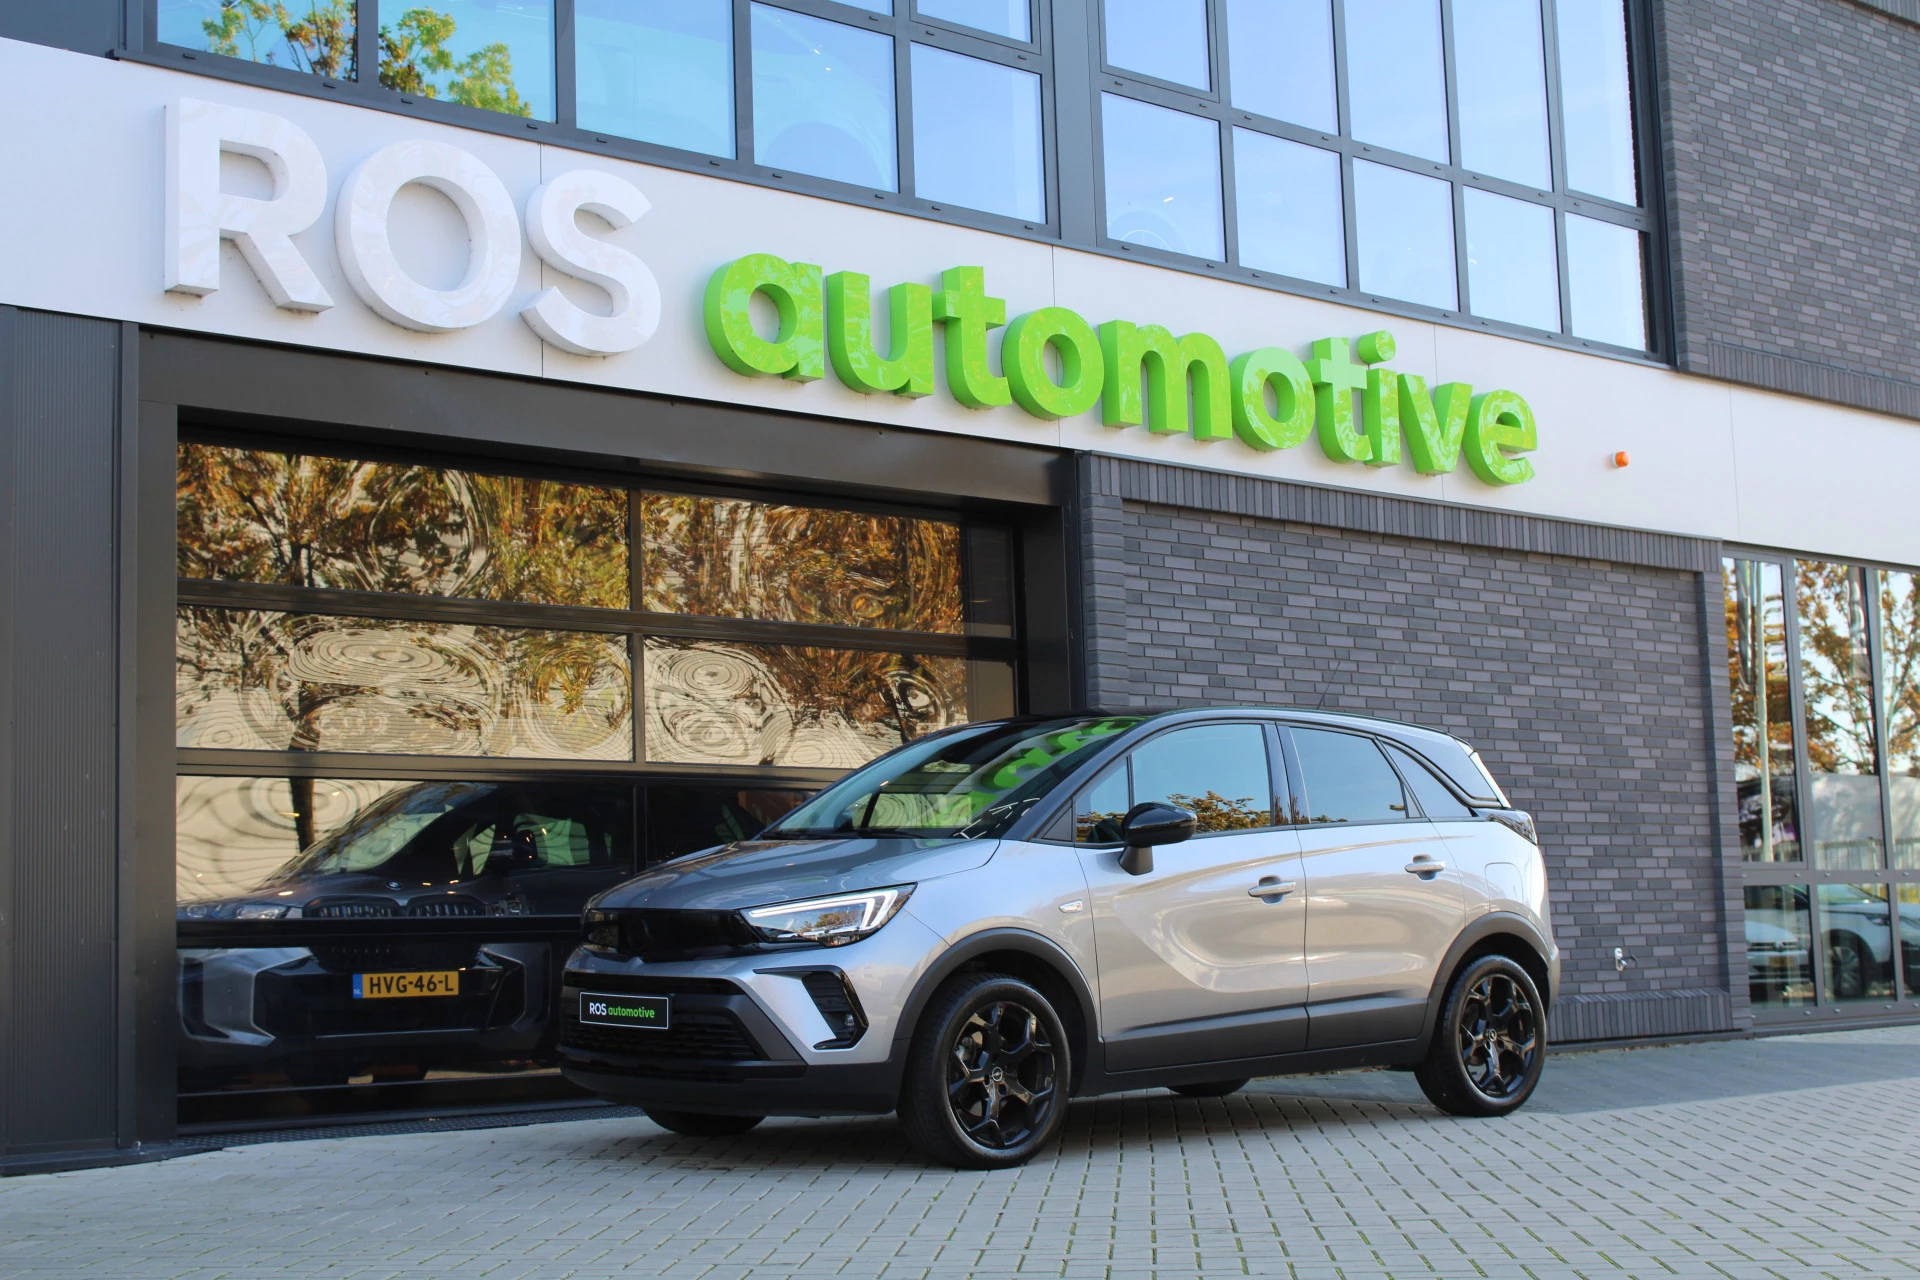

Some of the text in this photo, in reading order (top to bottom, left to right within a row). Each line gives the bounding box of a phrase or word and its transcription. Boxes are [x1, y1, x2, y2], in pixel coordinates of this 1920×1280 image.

[163, 96, 1538, 487] ROS automotive
[369, 974, 454, 994] HVG-46-L
[589, 1002, 655, 1018] ROS automotive
